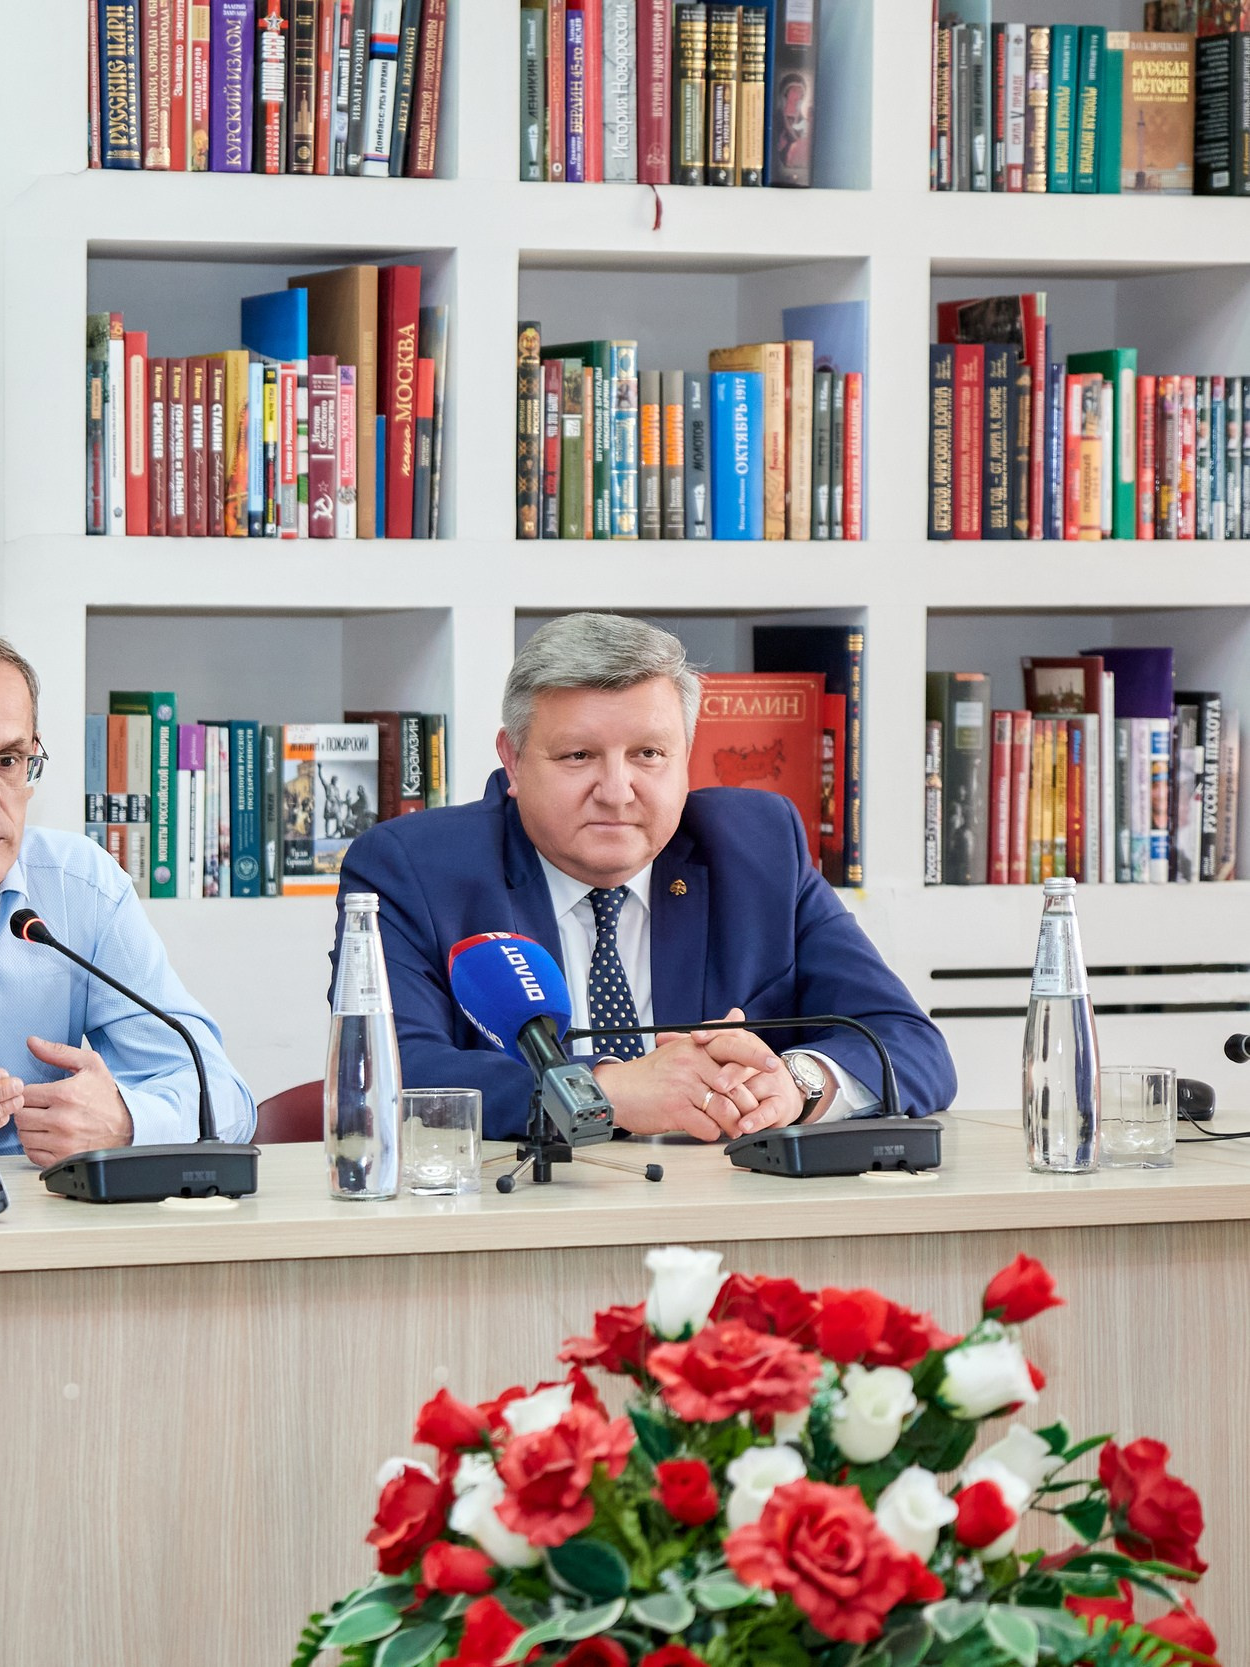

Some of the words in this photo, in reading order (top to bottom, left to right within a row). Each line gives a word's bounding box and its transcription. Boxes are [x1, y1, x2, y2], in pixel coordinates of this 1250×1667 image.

[106, 5, 126, 56] ЦАРИ
[148, 30, 159, 72] ОБРЯДЫ
[160, 9, 170, 51] НАРОДА
[227, 19, 242, 80] ИЗЛОМ
[262, 32, 285, 59] СССР
[425, 19, 438, 48] ВОЙНЫ
[610, 4, 633, 94] Новороссии
[160, 54, 171, 107] РУССКОГО
[174, 45, 184, 96] Завещано
[354, 28, 365, 85] ГРОЗНЫЙ
[403, 27, 416, 86] ВЕЛИКИЙ
[570, 47, 583, 78] 45-го
[1132, 60, 1190, 78] РУССКАЯ
[107, 60, 128, 145] РУССКИЕ
[128, 63, 137, 145] ДОМАШНЯЯ
[262, 62, 285, 101] АГОНИЯ
[338, 61, 350, 104] Николай
[352, 88, 362, 120] ИВАН
[528, 59, 538, 119] ДЕНИКИН
[1012, 74, 1023, 108] ПРАВДЕ
[1132, 77, 1190, 94] ИСТОРИЯ
[148, 75, 159, 142] ПРАЗДНИКИ,
[224, 84, 242, 165] КУРСКИЙ
[421, 91, 432, 122] ПЕРВОЙ
[570, 81, 583, 133] БЕРЛИН
[611, 97, 633, 159] История
[1012, 123, 1023, 145] СИЛА
[395, 323, 415, 422] МОСКВА
[595, 367, 603, 406] БРИГАДЫ
[735, 378, 746, 401] 1917
[312, 405, 321, 442] История
[319, 399, 328, 448] Советского
[327, 399, 336, 449] государства
[341, 394, 349, 439] МОСКВЫ
[934, 386, 948, 426] ВОЙНА
[989, 386, 1002, 418] ВОЙНЕ
[152, 402, 163, 458] БРЕЖНЕВ
[175, 404, 184, 459] ГОРБАЧЕВ
[192, 404, 204, 449] ПУТИН
[212, 403, 223, 451] СТАЛИН
[642, 404, 660, 465] МОЛОТОВ
[665, 404, 684, 465] МОЛОТОВ
[693, 420, 704, 471] МОЛОТОВ
[734, 403, 749, 474] ОКТЯБРЬ
[341, 441, 350, 478] История
[934, 428, 948, 484] МИРОВАЯ
[174, 471, 184, 515] ЕЛЬЦИН
[934, 487, 950, 531] ПЕРВАЯ
[703, 696, 799, 716] СТАЛИН
[1204, 699, 1221, 760] ПЕХОТА
[159, 726, 169, 767] ИМПЕРИИ
[237, 729, 245, 763] РУССКОЙ
[326, 735, 369, 753] ПОЖАРСКИЙ
[402, 718, 422, 796] Карамзин
[157, 769, 169, 825] РОССИЙСКОЙ
[1203, 763, 1219, 834] РУССКАЯ
[158, 826, 168, 862] МОНЕТЫ
[500, 945, 546, 1002] ОПЛОТ
